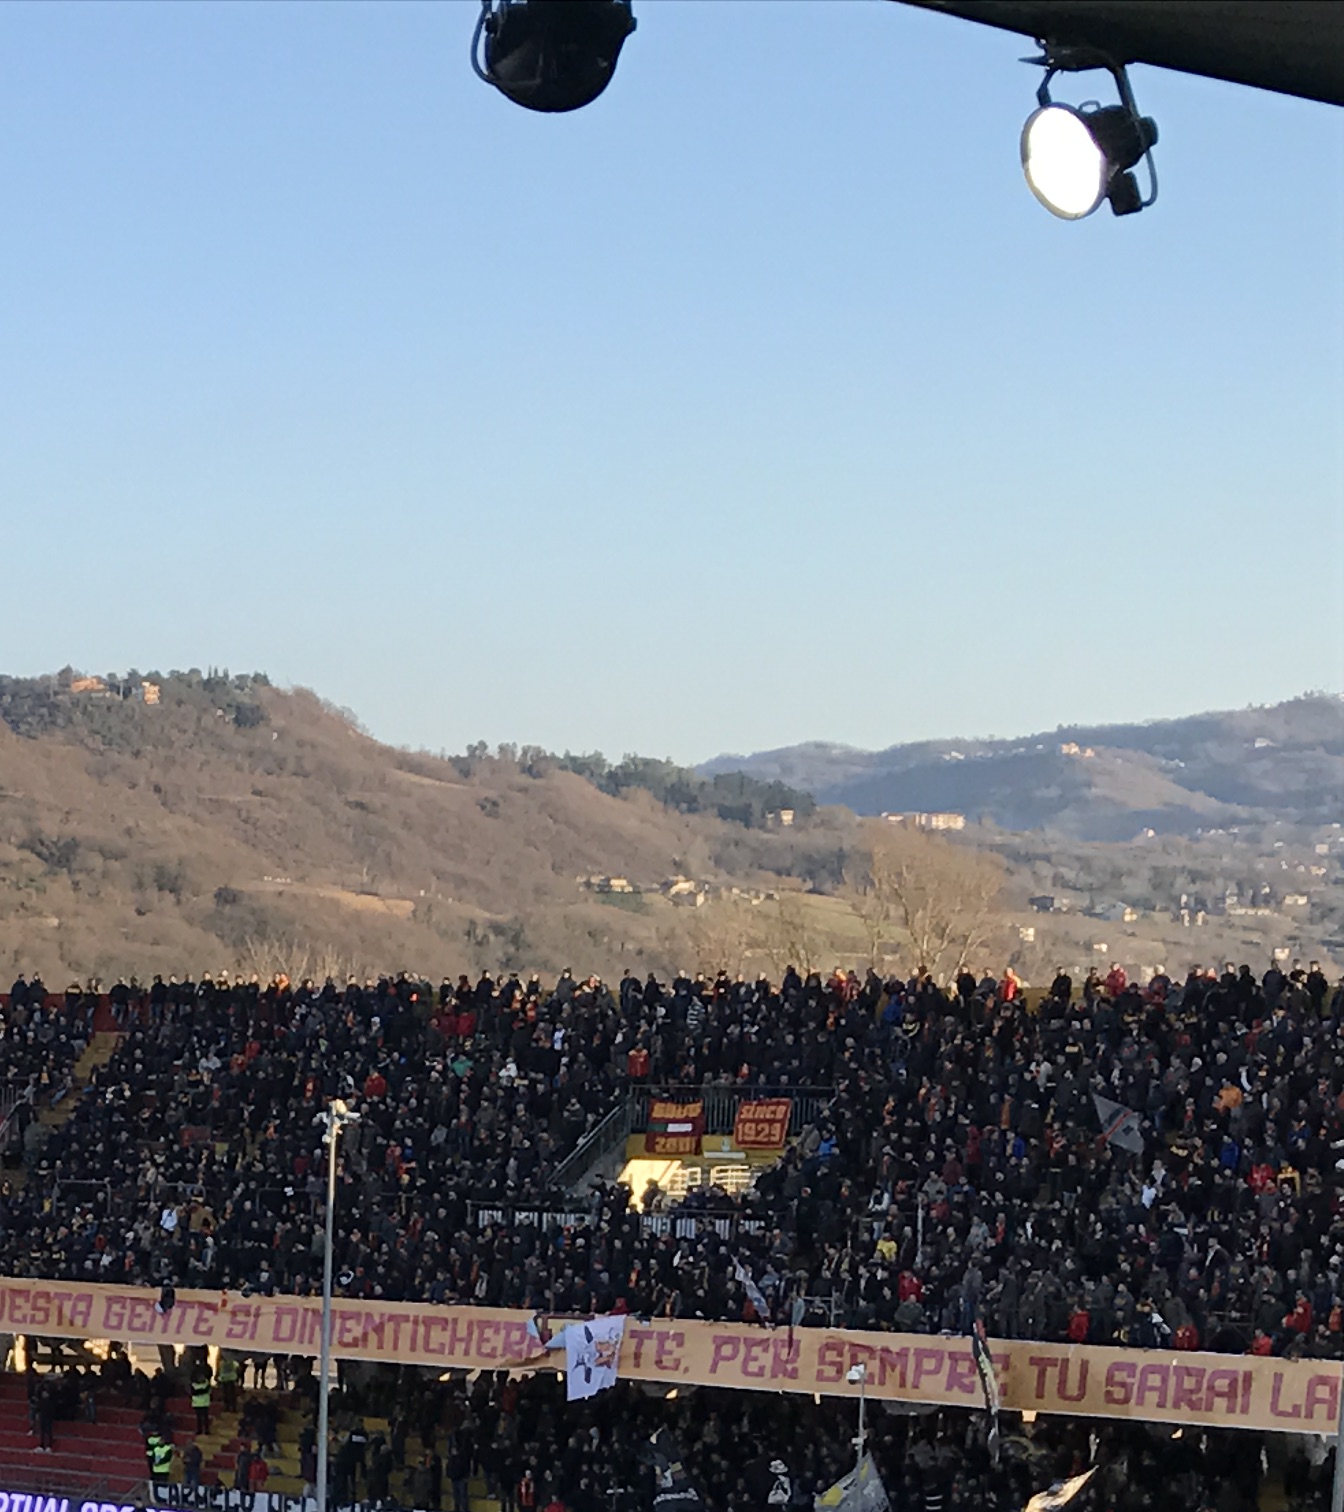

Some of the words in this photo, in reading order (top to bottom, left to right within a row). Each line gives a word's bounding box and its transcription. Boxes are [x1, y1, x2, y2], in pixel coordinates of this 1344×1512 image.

[102, 1294, 219, 1336] GENTE
[709, 1335, 802, 1380] PER
[816, 1340, 1011, 1398] SEMPRE
[1029, 1356, 1089, 1402] TU
[1104, 1361, 1253, 1415] SARAI
[1270, 1372, 1339, 1420] LA
